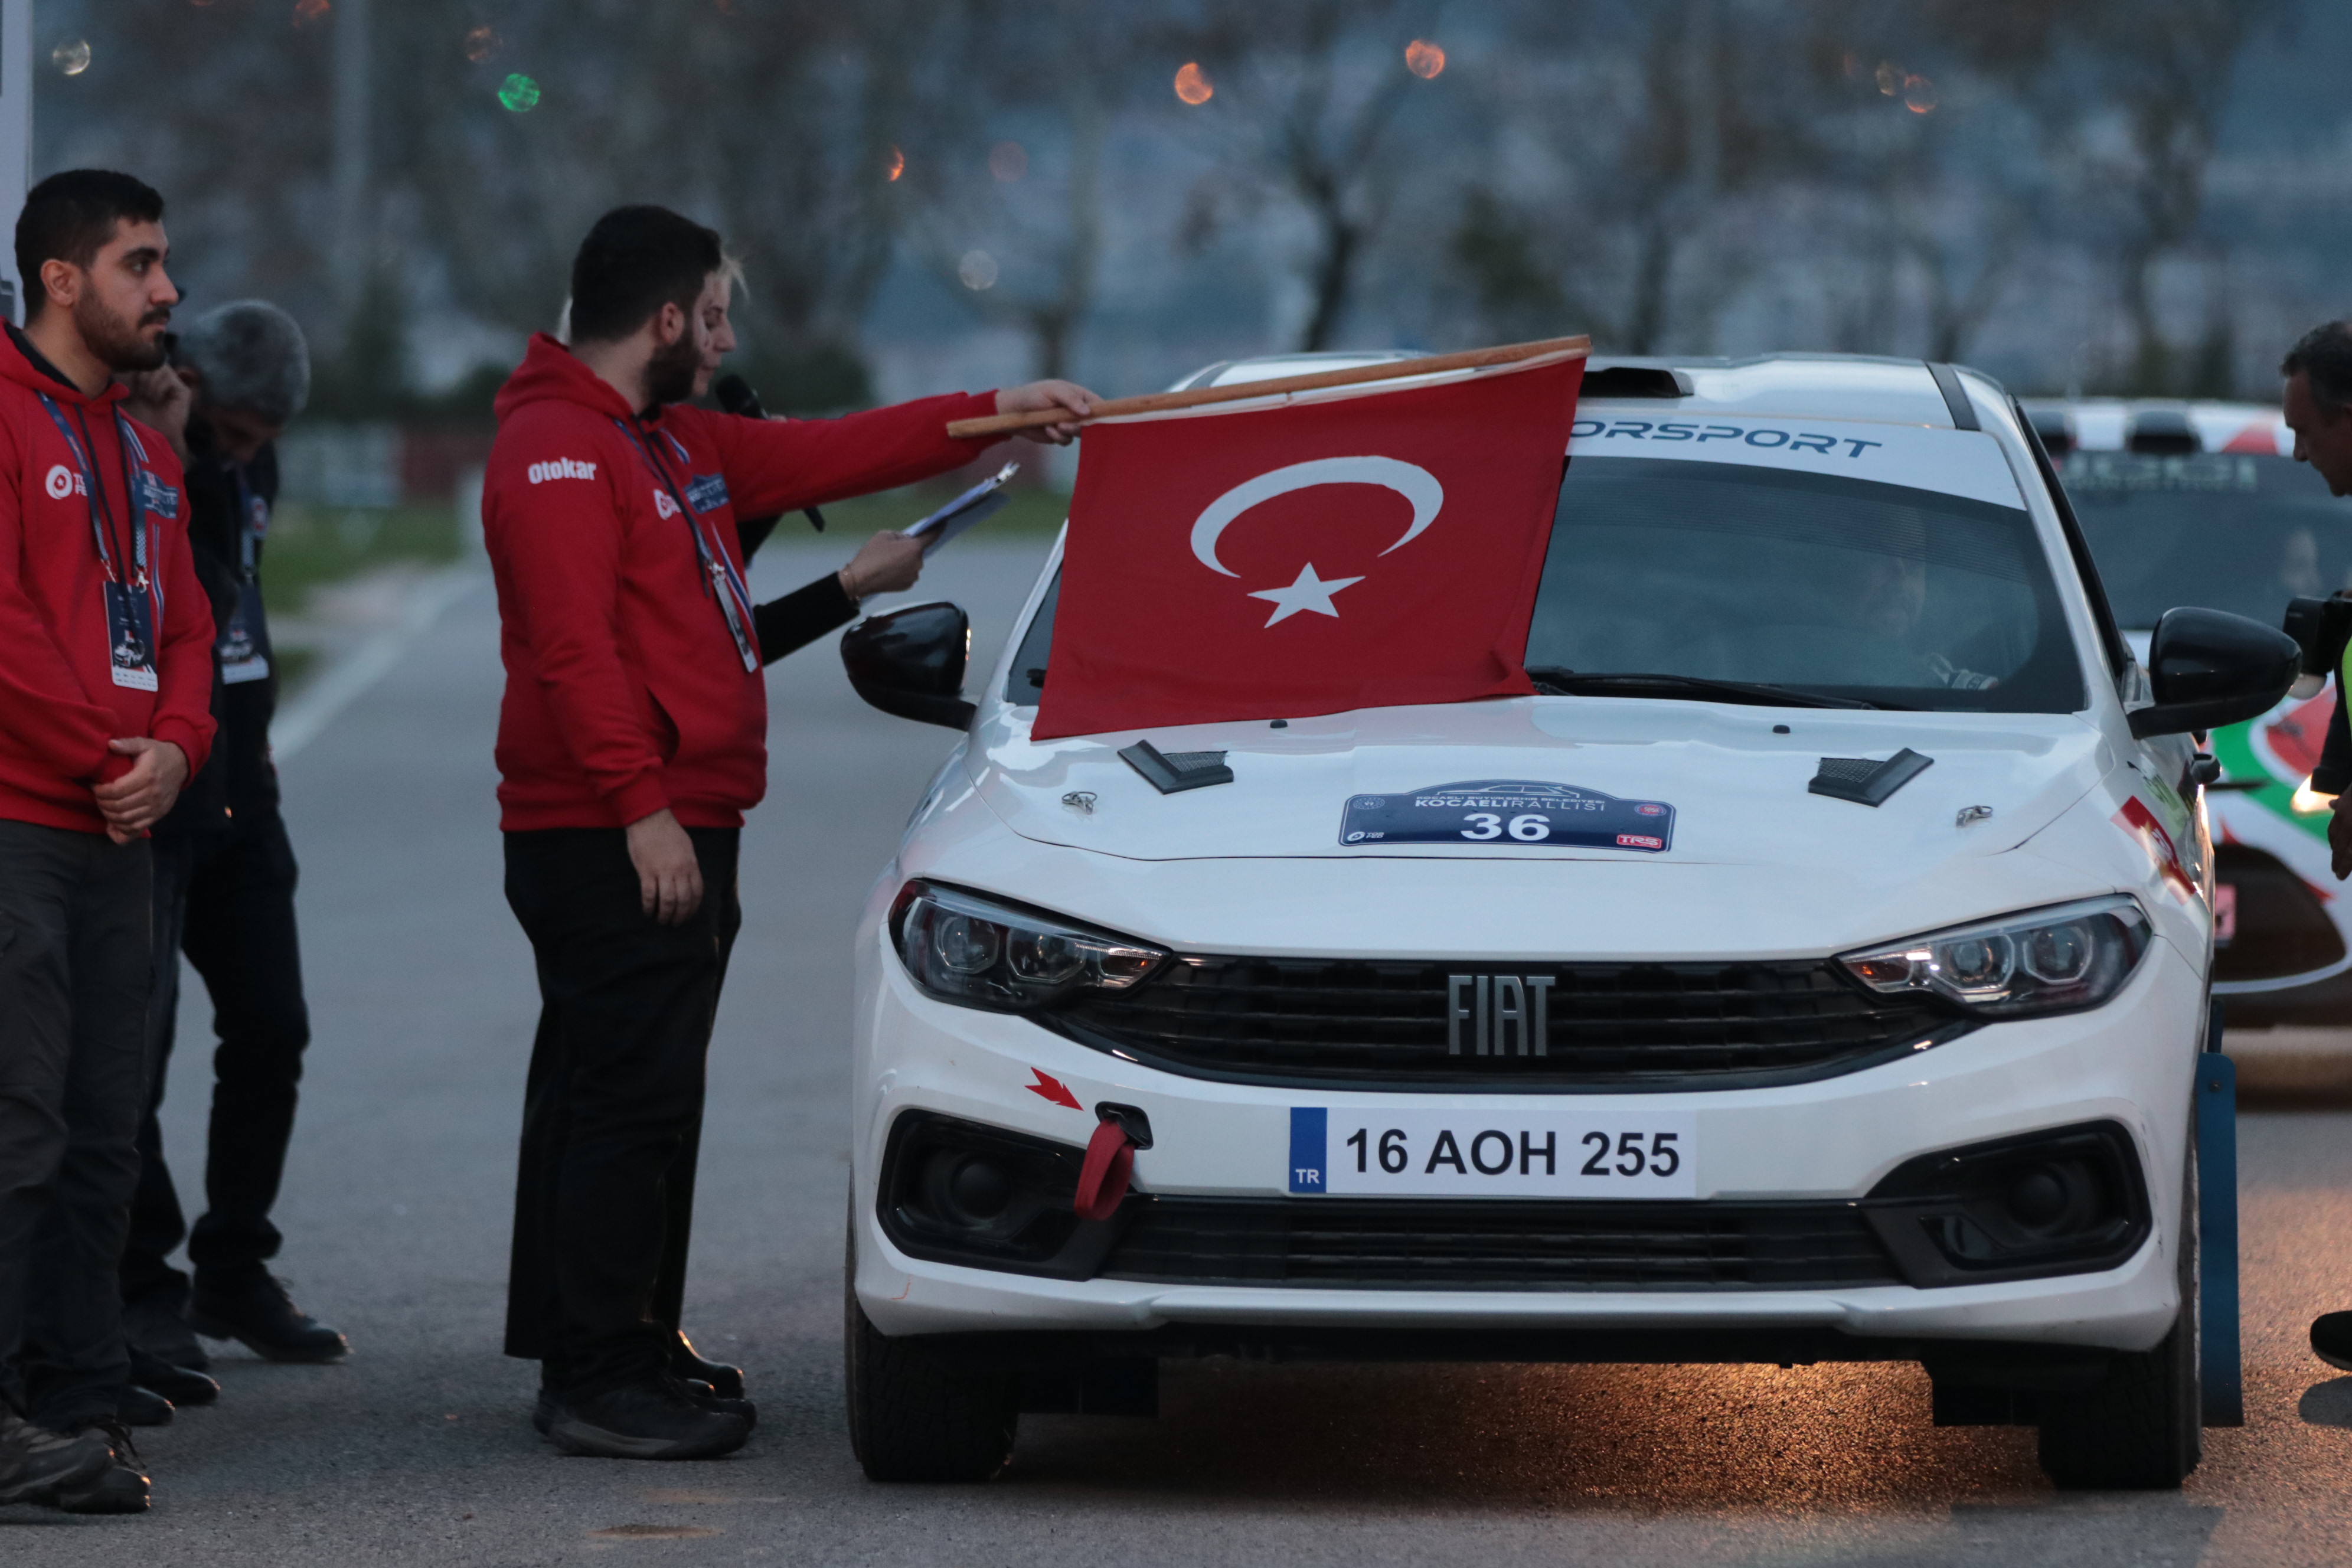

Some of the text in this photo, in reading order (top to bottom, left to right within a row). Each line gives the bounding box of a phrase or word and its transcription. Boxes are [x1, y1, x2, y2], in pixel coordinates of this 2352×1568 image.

[528, 456, 597, 484] otokar
[1461, 812, 1550, 841] 36
[1620, 835, 1659, 845] TRS
[1449, 975, 1556, 1056] FIAT
[1347, 1128, 1680, 1177] 16 AOH 255
[1295, 1168, 1320, 1184] TR
